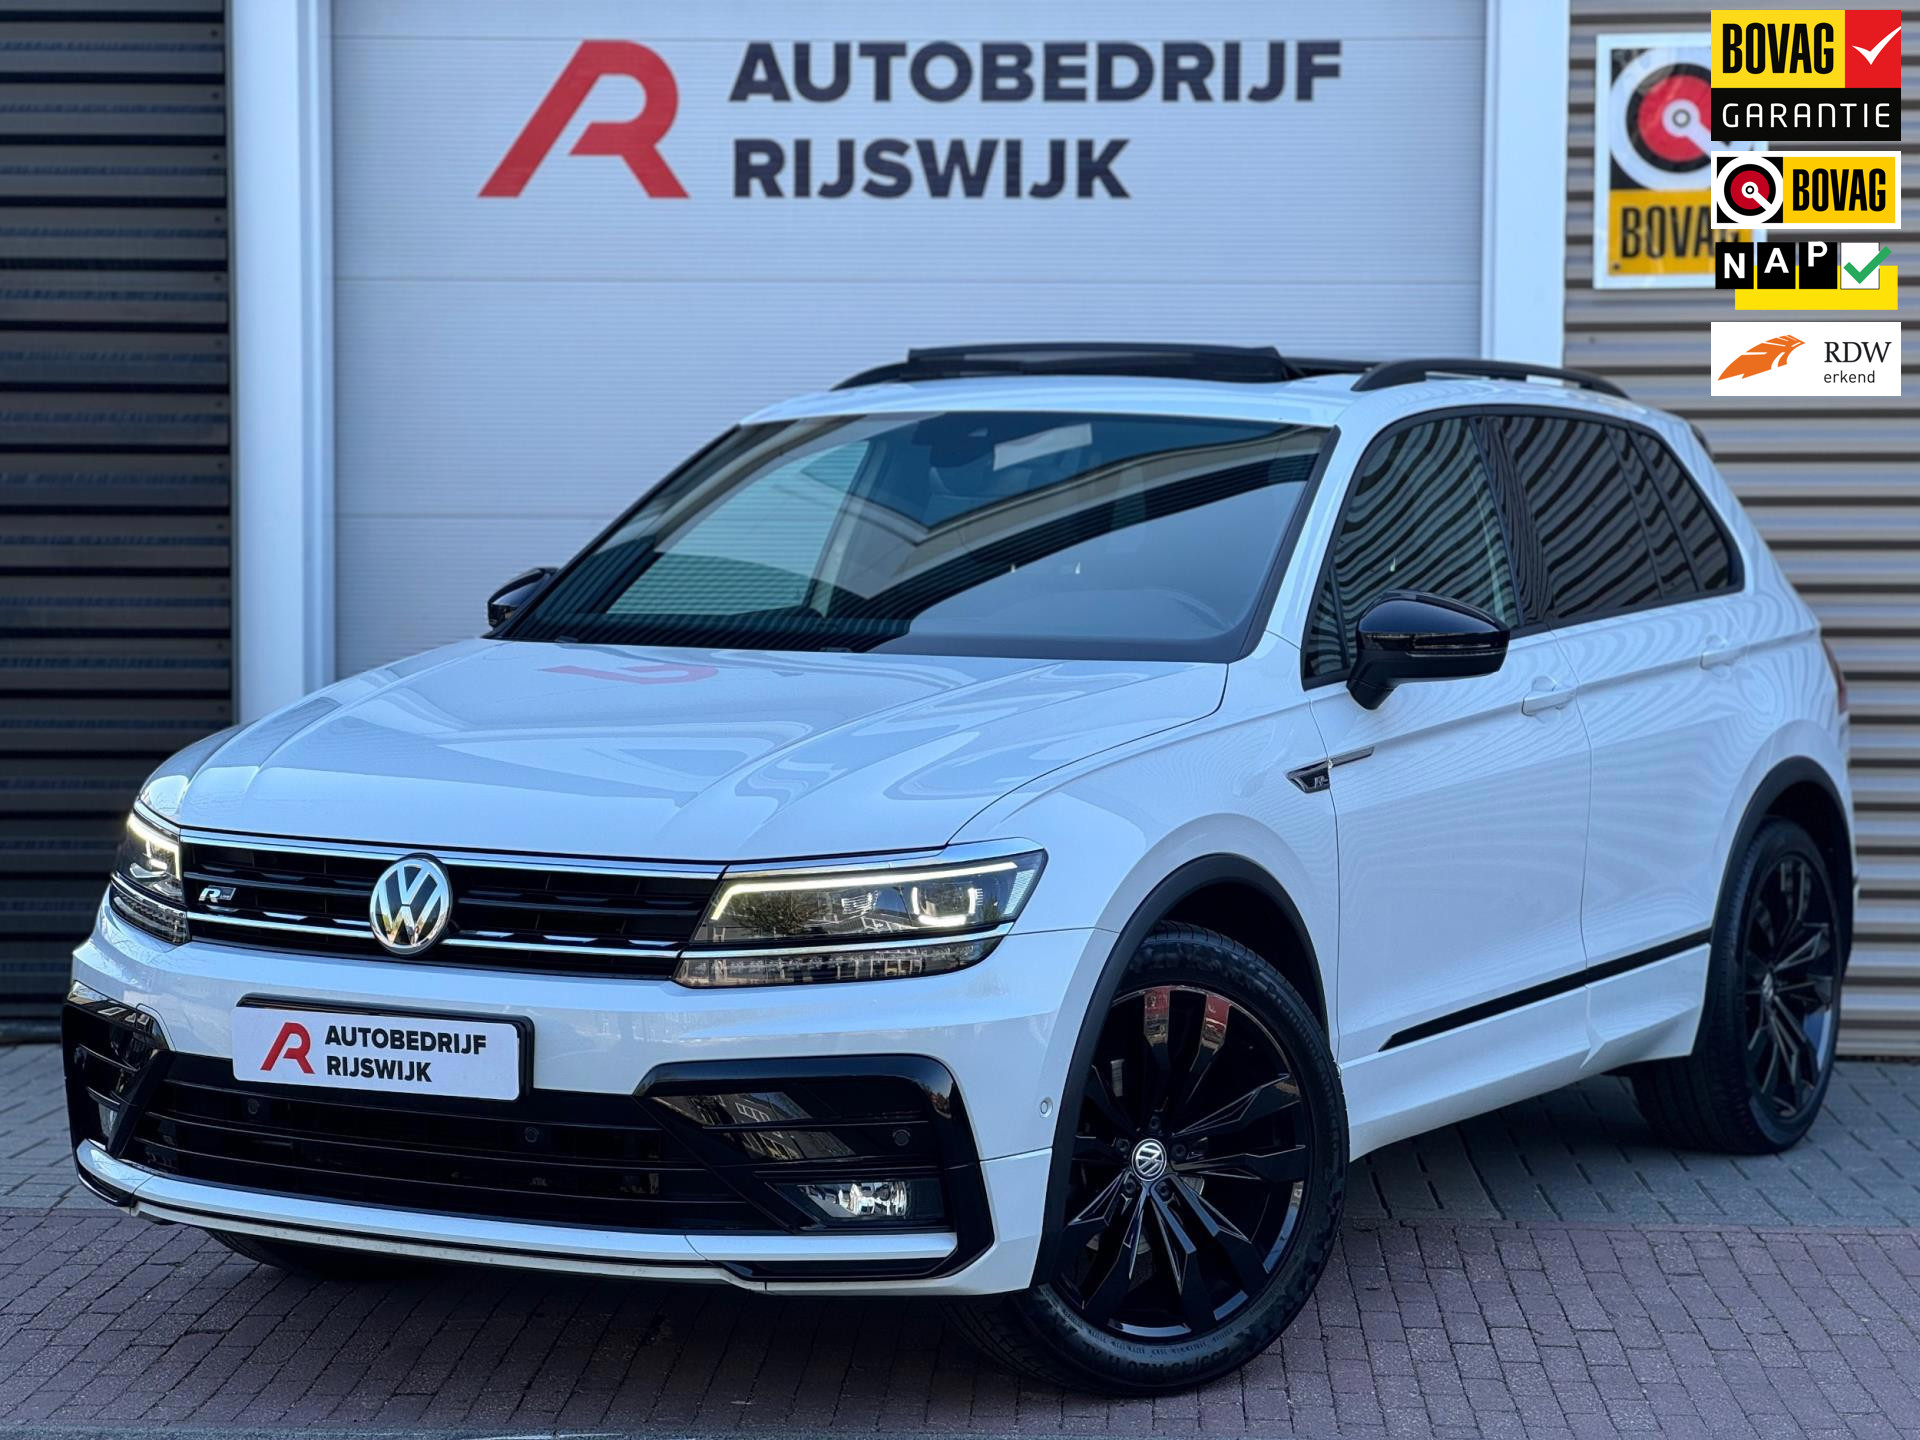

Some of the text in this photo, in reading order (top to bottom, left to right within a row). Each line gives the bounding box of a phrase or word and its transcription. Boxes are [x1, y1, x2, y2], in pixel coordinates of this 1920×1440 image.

[729, 40, 1342, 103] AUTOBEDRIJF
[733, 138, 1131, 199] RIJSWIJK
[1620, 204, 1739, 259] BOVA
[325, 1025, 487, 1055] AUTOBEDRIJF
[327, 1055, 433, 1083] RIJSWIJK
